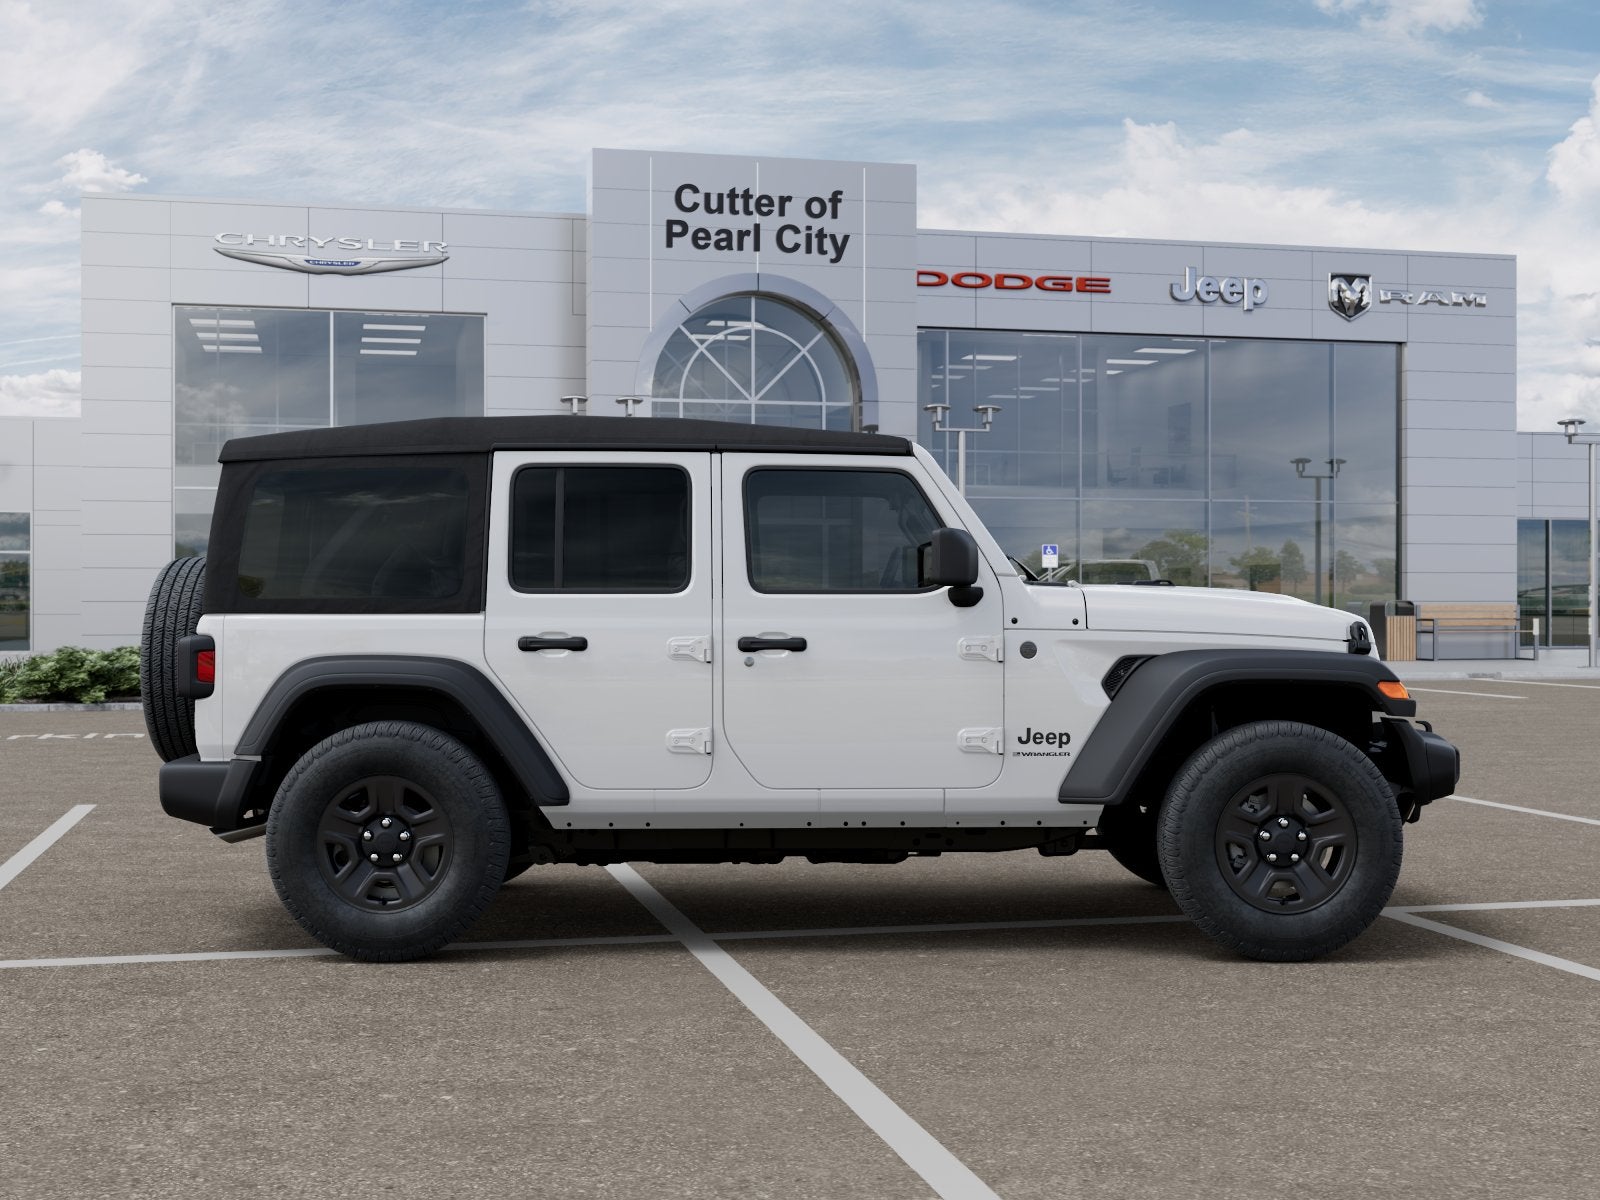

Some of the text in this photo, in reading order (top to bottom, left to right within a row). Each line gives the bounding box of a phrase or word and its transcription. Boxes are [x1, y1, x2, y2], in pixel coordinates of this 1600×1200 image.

[674, 183, 844, 219] Cutter of
[214, 232, 449, 253] CHRYSLER
[665, 219, 851, 264] Pearl City
[309, 259, 356, 267] CHRYSLER
[916, 270, 1111, 294] DODGE
[1169, 266, 1269, 311] Jeep
[1379, 289, 1488, 308] RAM
[1017, 727, 1071, 749] Jeep
